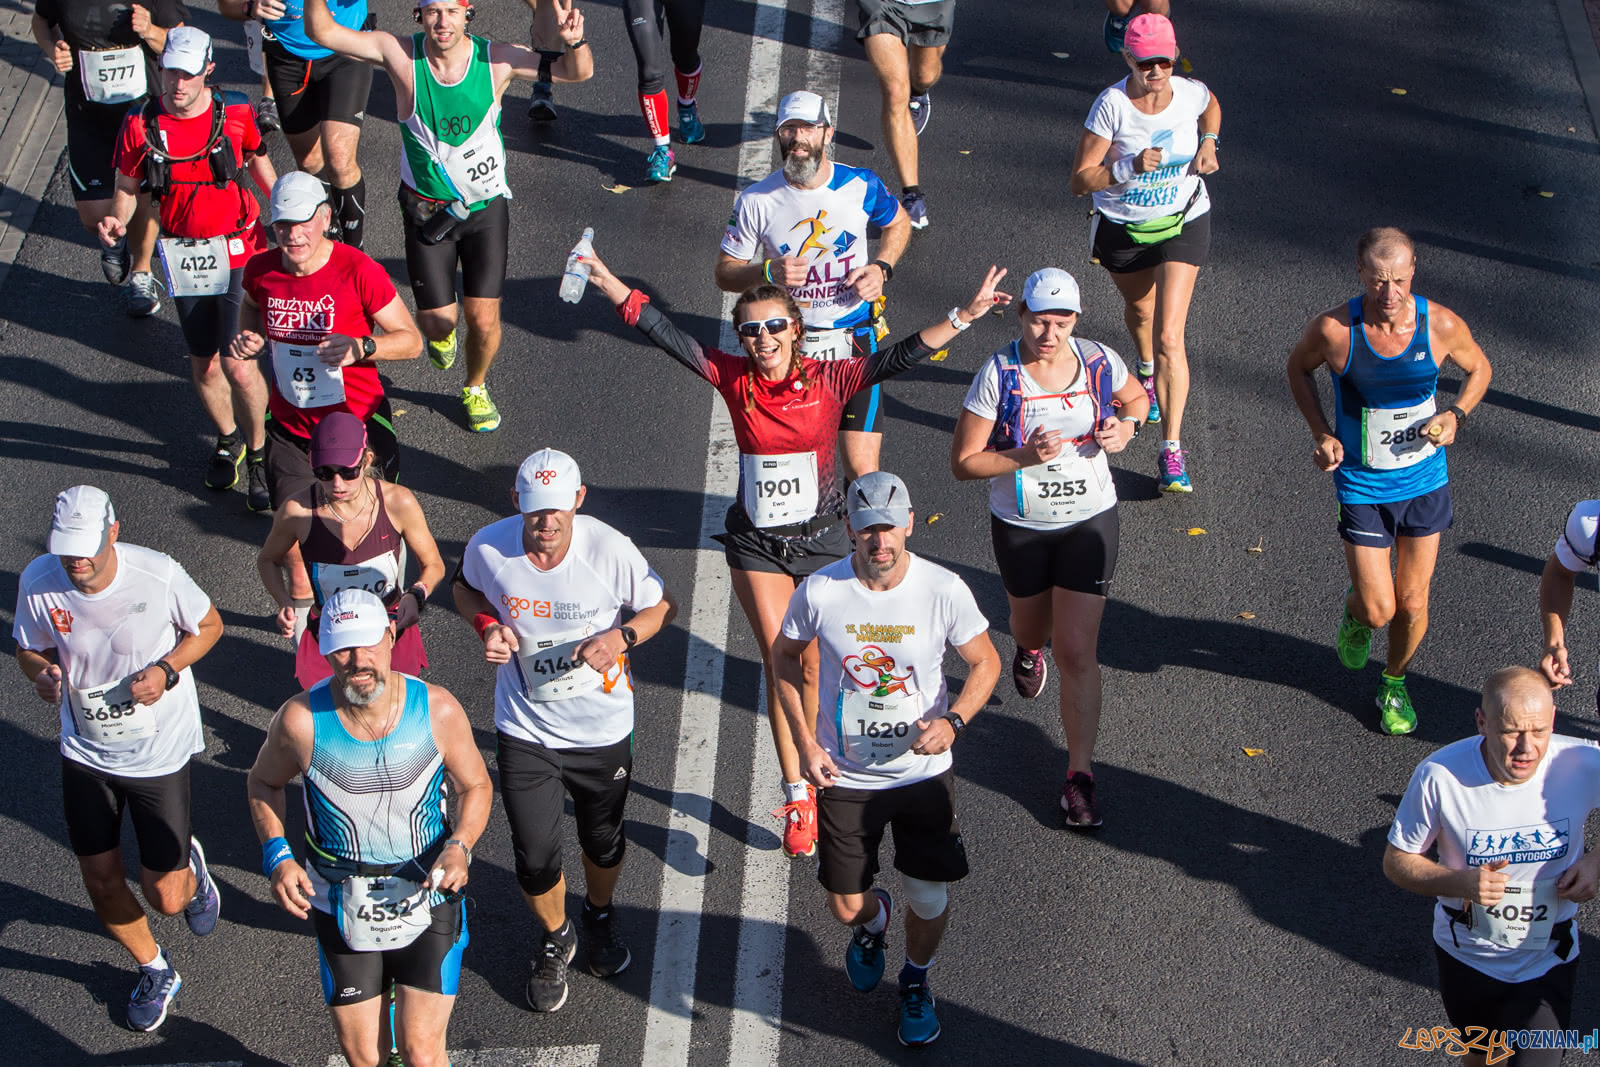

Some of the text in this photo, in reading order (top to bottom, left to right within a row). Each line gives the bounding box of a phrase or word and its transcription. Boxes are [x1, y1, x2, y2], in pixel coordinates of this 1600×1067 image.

[98, 65, 135, 82] 5777
[439, 115, 471, 137] 960
[466, 156, 499, 182] 202
[180, 256, 217, 272] 4122
[803, 253, 856, 287] ALT
[267, 297, 322, 312] DRUŻYNA
[811, 292, 855, 309] BOCHNIA
[267, 310, 336, 331] SZPIKU
[269, 331, 322, 342] www.darszpiku
[293, 367, 316, 383] 63
[755, 477, 801, 499] 1901
[1037, 479, 1088, 500] 3253
[554, 601, 581, 612] ŚREM
[82, 701, 136, 721] 3683
[857, 719, 909, 739] 1620
[357, 898, 413, 922] 4532
[1486, 904, 1548, 922] 4052
[1506, 924, 1527, 932] Jacek
